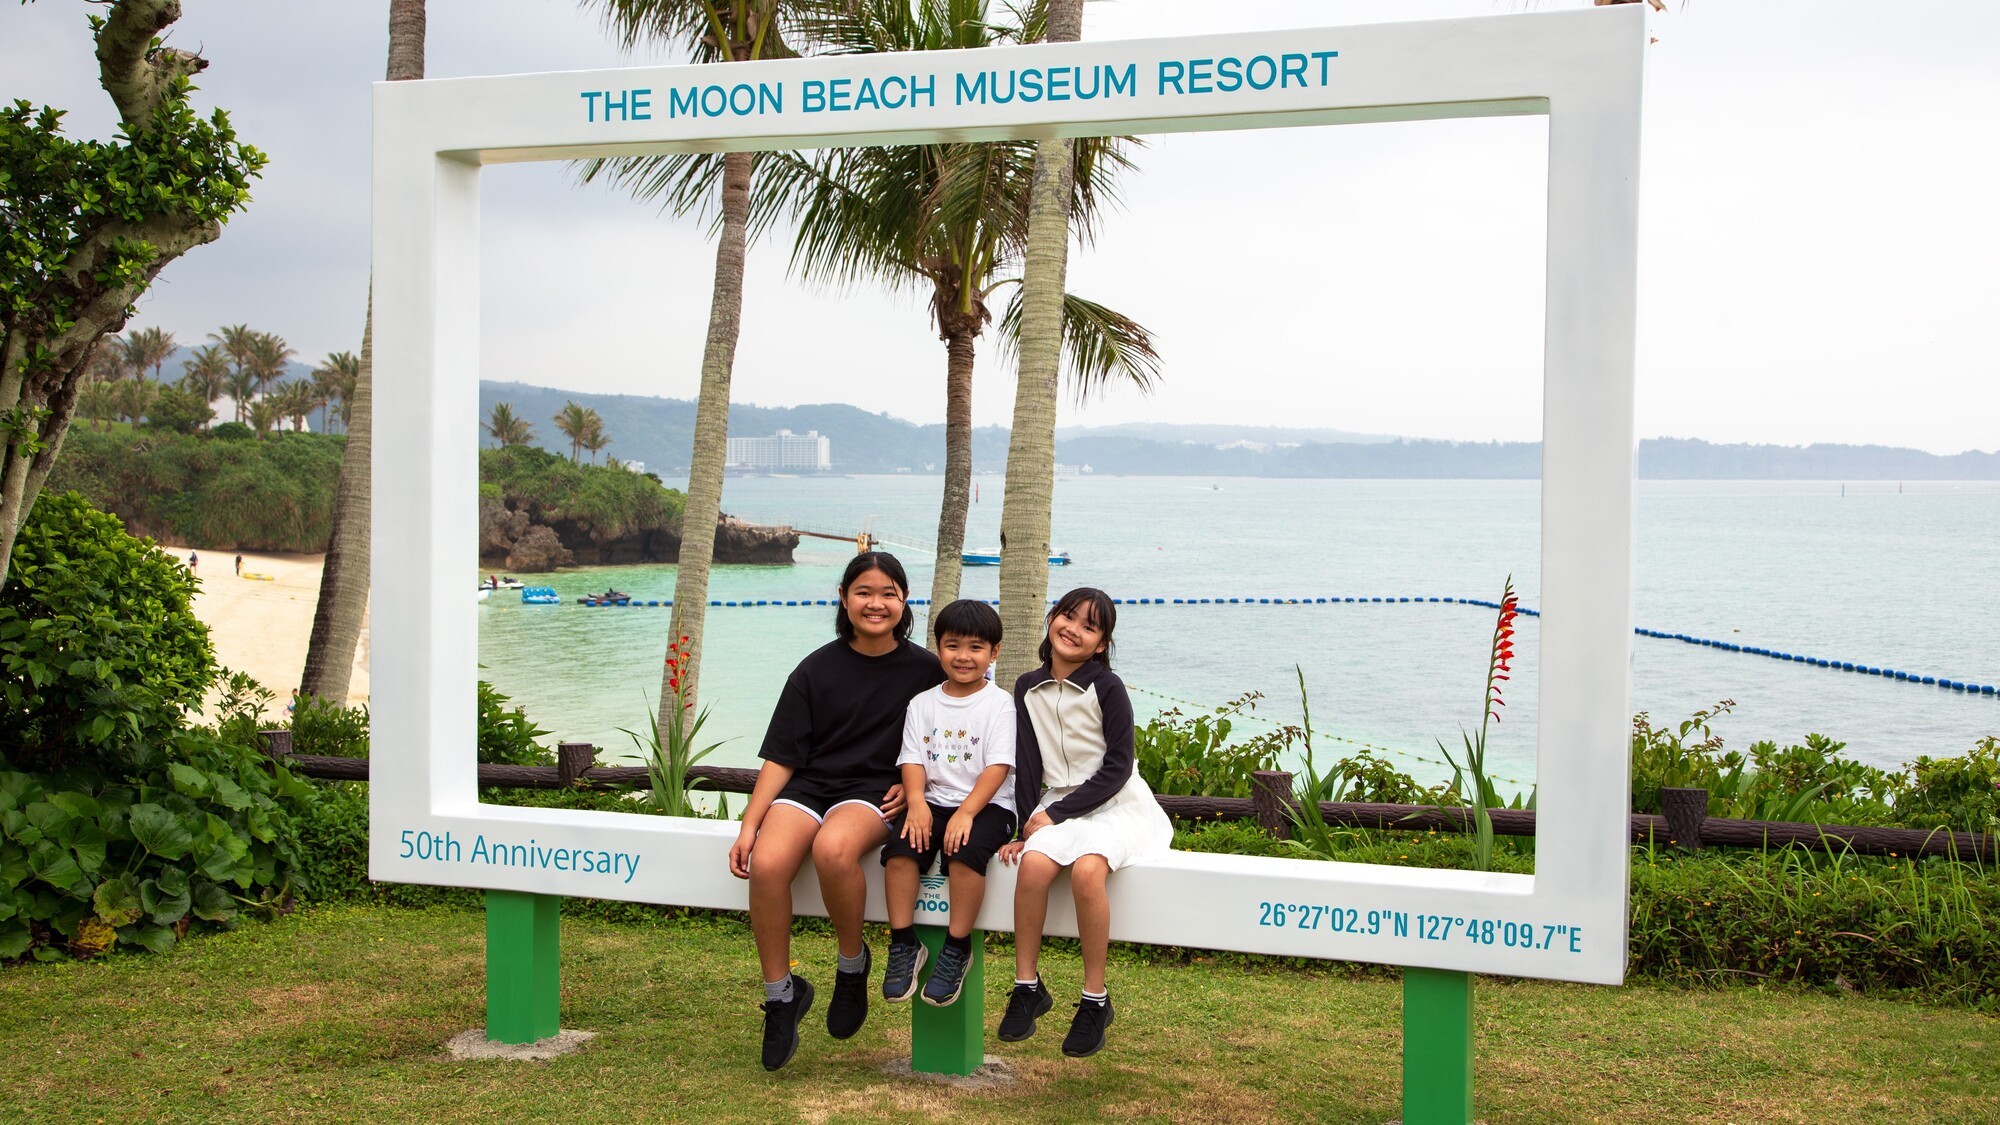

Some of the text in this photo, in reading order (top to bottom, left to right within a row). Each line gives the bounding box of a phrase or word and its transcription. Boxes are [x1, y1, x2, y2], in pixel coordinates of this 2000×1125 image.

[580, 50, 1339, 123] THE MOON BEACH MUSEUM RESORT
[399, 829, 641, 884] 50th Anniversary
[1259, 901, 1582, 953] 26°27'02.9"N 127°48'09.7"E
